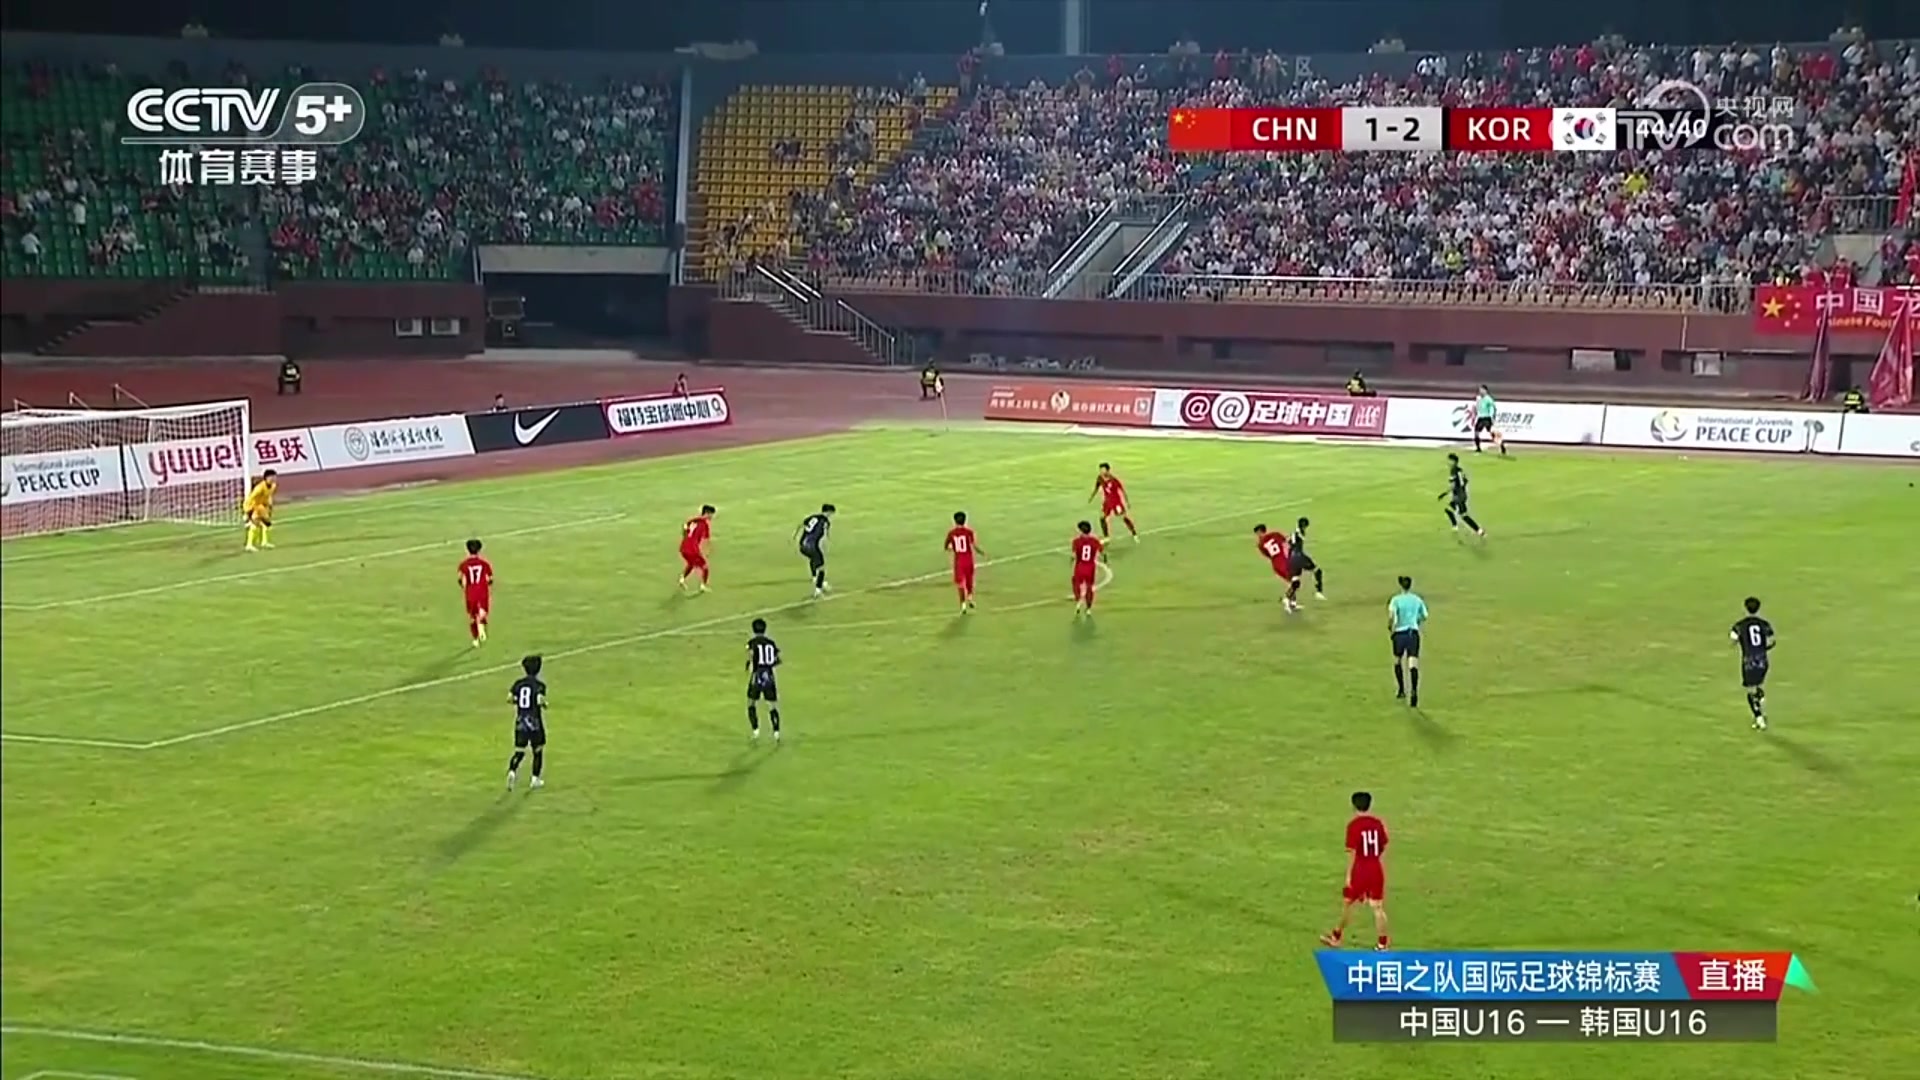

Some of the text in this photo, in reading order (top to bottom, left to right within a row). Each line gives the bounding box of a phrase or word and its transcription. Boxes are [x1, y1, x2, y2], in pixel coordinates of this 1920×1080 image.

[1816, 316, 1863, 328] Cinese
[1250, 400, 1353, 426] 足球中国
[1698, 415, 1793, 427] International Juvenile
[1696, 426, 1792, 444] PEACE CUP
[254, 436, 308, 466] 鱼跃
[17, 467, 100, 493] PEACE CUP
[954, 535, 967, 553] 10
[1081, 545, 1092, 561] 8
[1263, 538, 1281, 557] 16
[467, 564, 483, 585] 17
[1749, 624, 1762, 646] 6
[758, 644, 775, 666] 10
[519, 686, 531, 709] 8
[1361, 830, 1380, 857] 14
